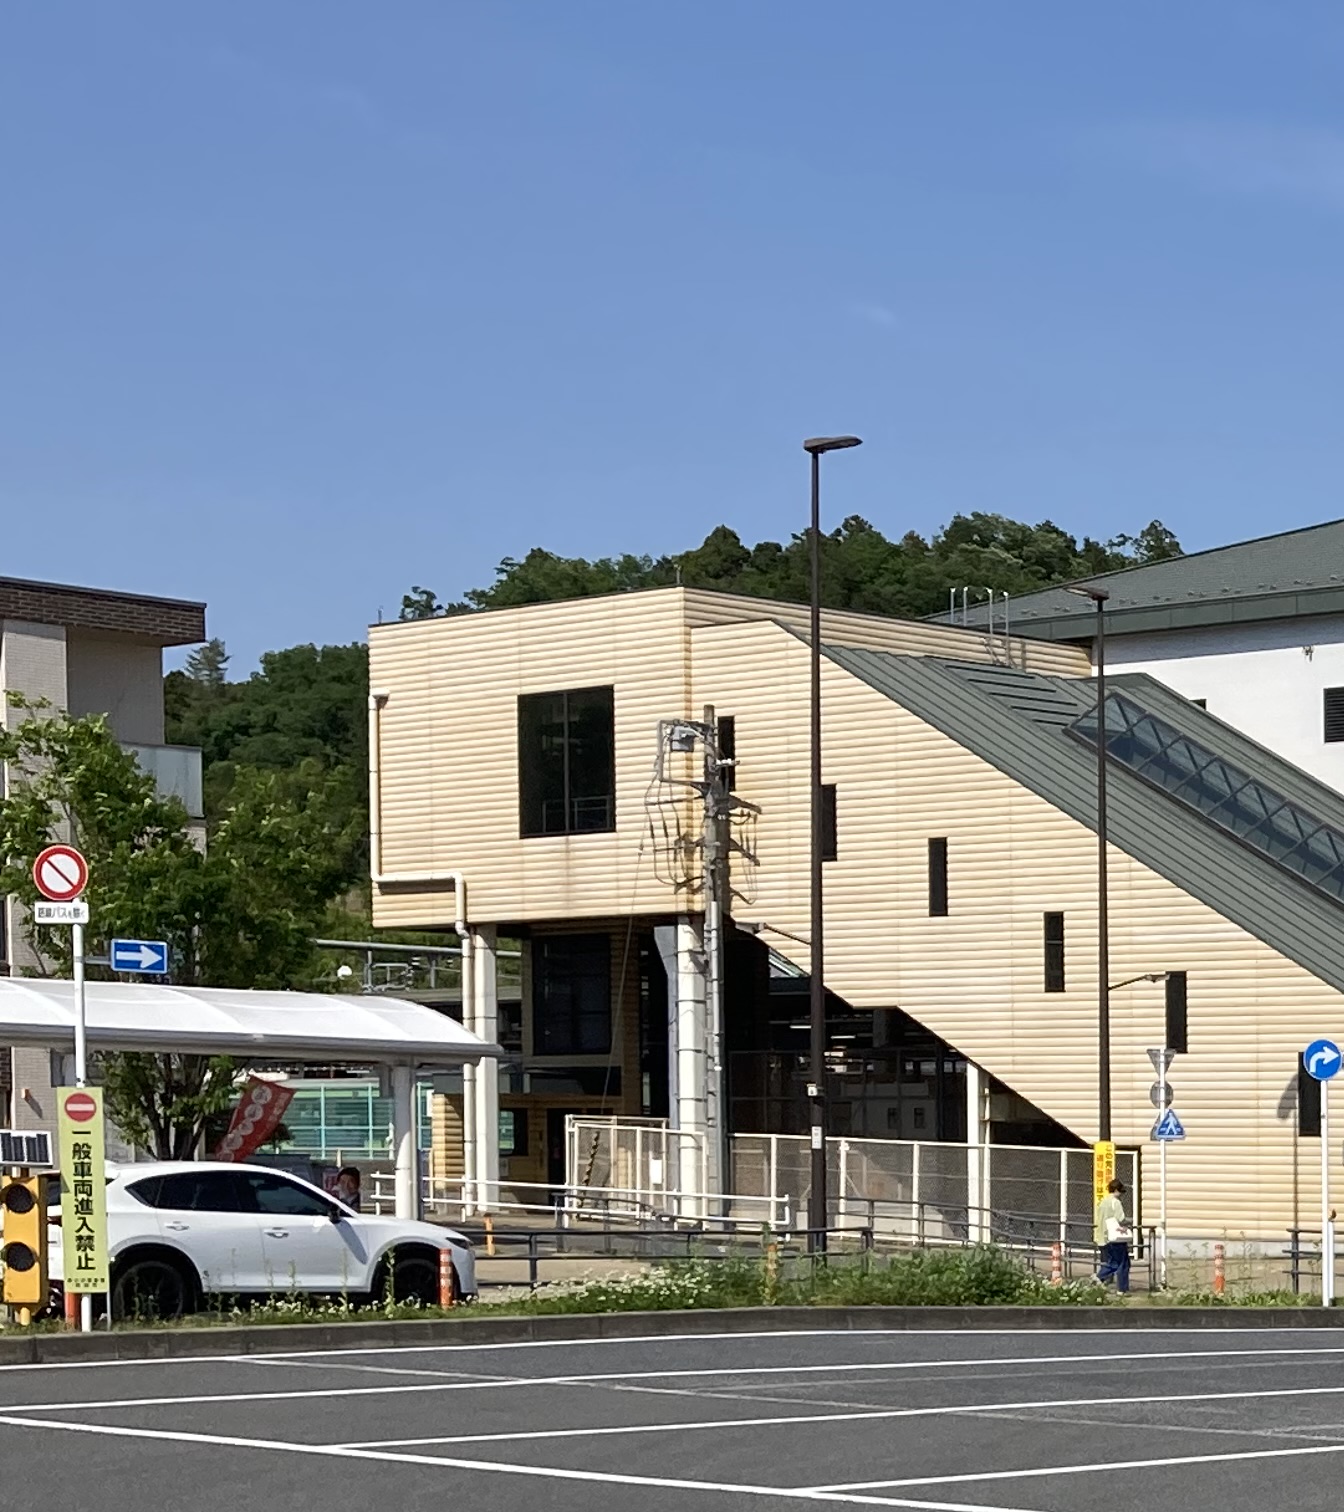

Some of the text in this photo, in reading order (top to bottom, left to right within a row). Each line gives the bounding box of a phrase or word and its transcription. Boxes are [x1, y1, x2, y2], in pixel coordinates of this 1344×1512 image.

[72, 1130, 96, 1271] 一般車両進入禁止
